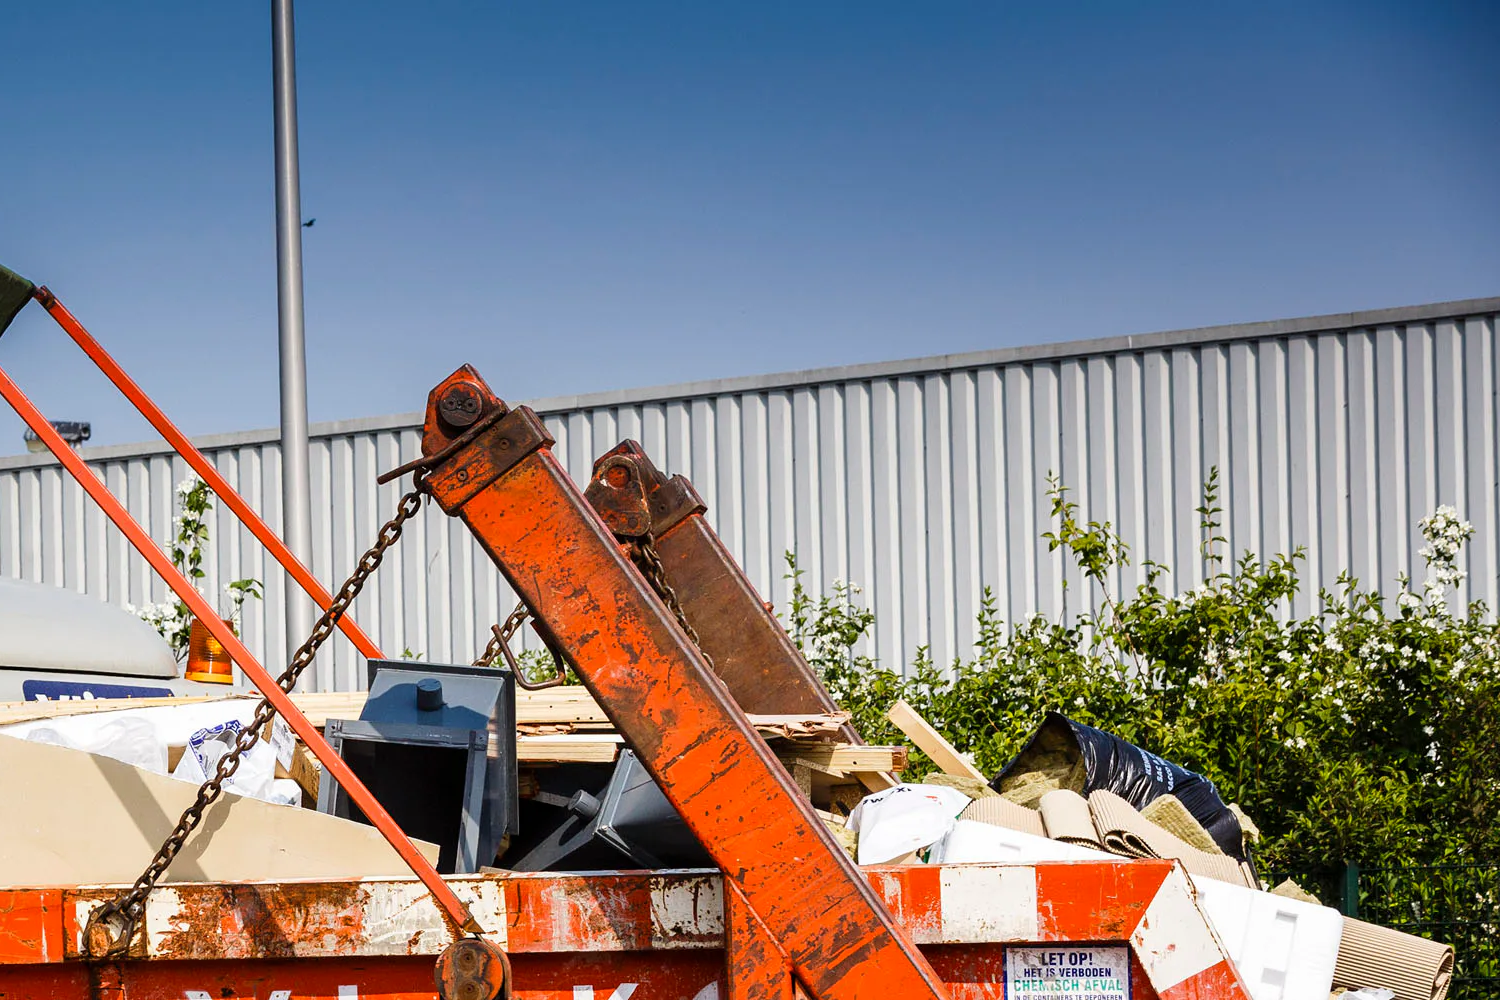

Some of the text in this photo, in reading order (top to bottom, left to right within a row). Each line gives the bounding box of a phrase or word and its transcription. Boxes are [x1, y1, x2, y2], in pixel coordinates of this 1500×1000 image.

[1041, 952, 1094, 966] LET OP!
[1024, 967, 1112, 978] HET IS VERBODEN
[1085, 979, 1123, 991] AFVAL
